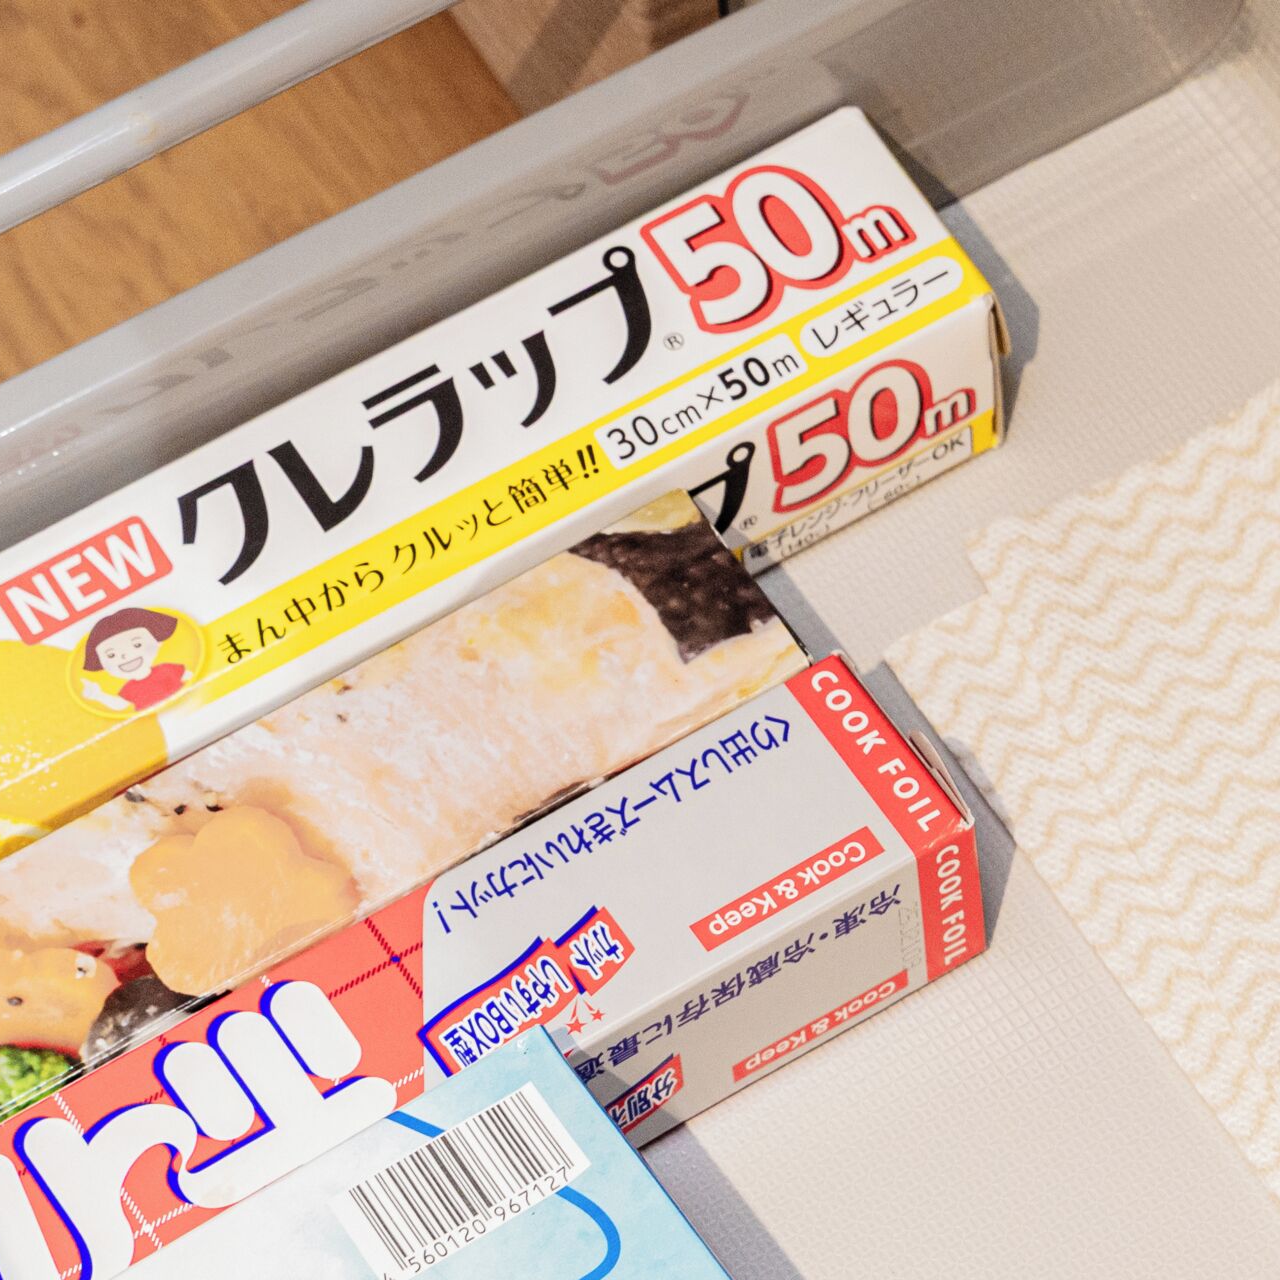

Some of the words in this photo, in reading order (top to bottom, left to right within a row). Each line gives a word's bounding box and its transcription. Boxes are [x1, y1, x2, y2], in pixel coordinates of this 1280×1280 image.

[811, 267, 951, 352] レギュラー
[5, 522, 158, 637] NEW
[177, 244, 653, 587] クレラップ
[642, 166, 916, 334] 50m
[768, 360, 976, 512] 50m
[810, 670, 886, 755] COOK
[877, 756, 946, 833] FOIL
[773, 878, 799, 900] &
[797, 841, 867, 886] Cook
[935, 844, 965, 911] COOK
[708, 891, 778, 936] Keep
[941, 909, 968, 966] FOIL
[835, 980, 896, 1022] Cook
[745, 1029, 808, 1071] Keep
